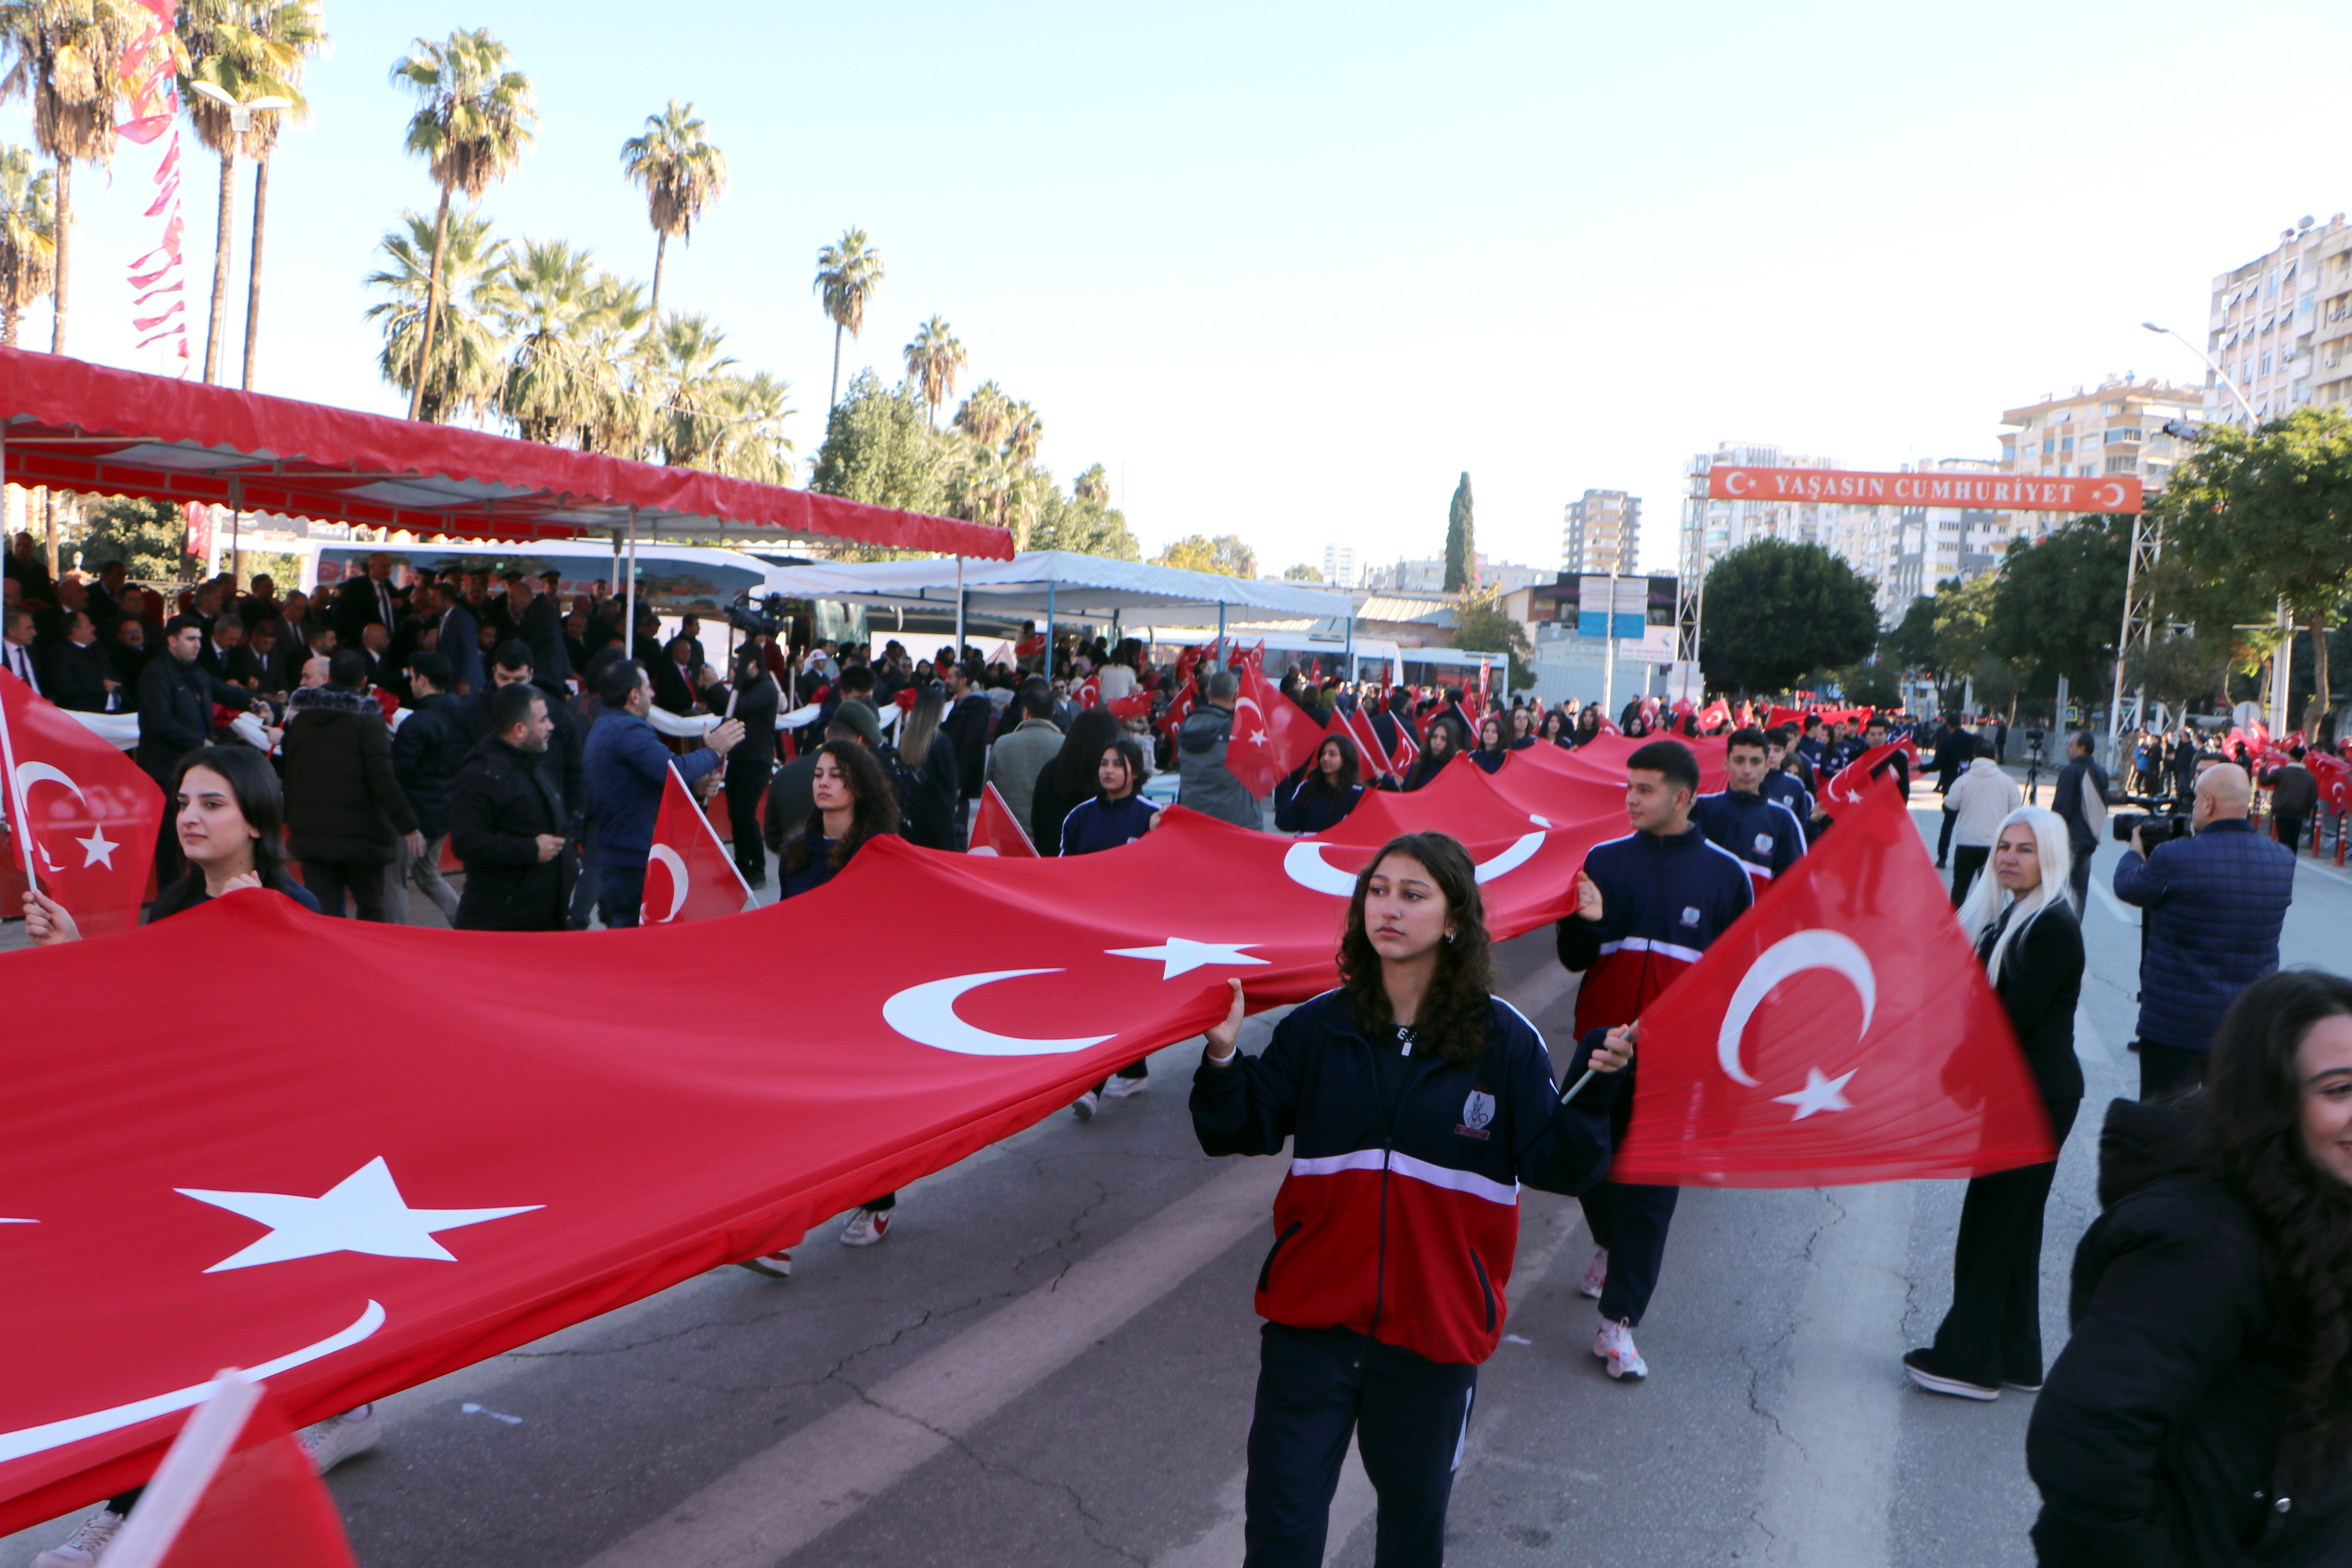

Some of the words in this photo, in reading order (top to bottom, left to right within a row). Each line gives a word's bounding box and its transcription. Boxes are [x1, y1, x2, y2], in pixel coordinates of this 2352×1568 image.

[1775, 475, 1884, 500] YAŞASIN
[1895, 477, 2075, 503] CUMHURİYET
[1397, 1027, 1408, 1040] E
